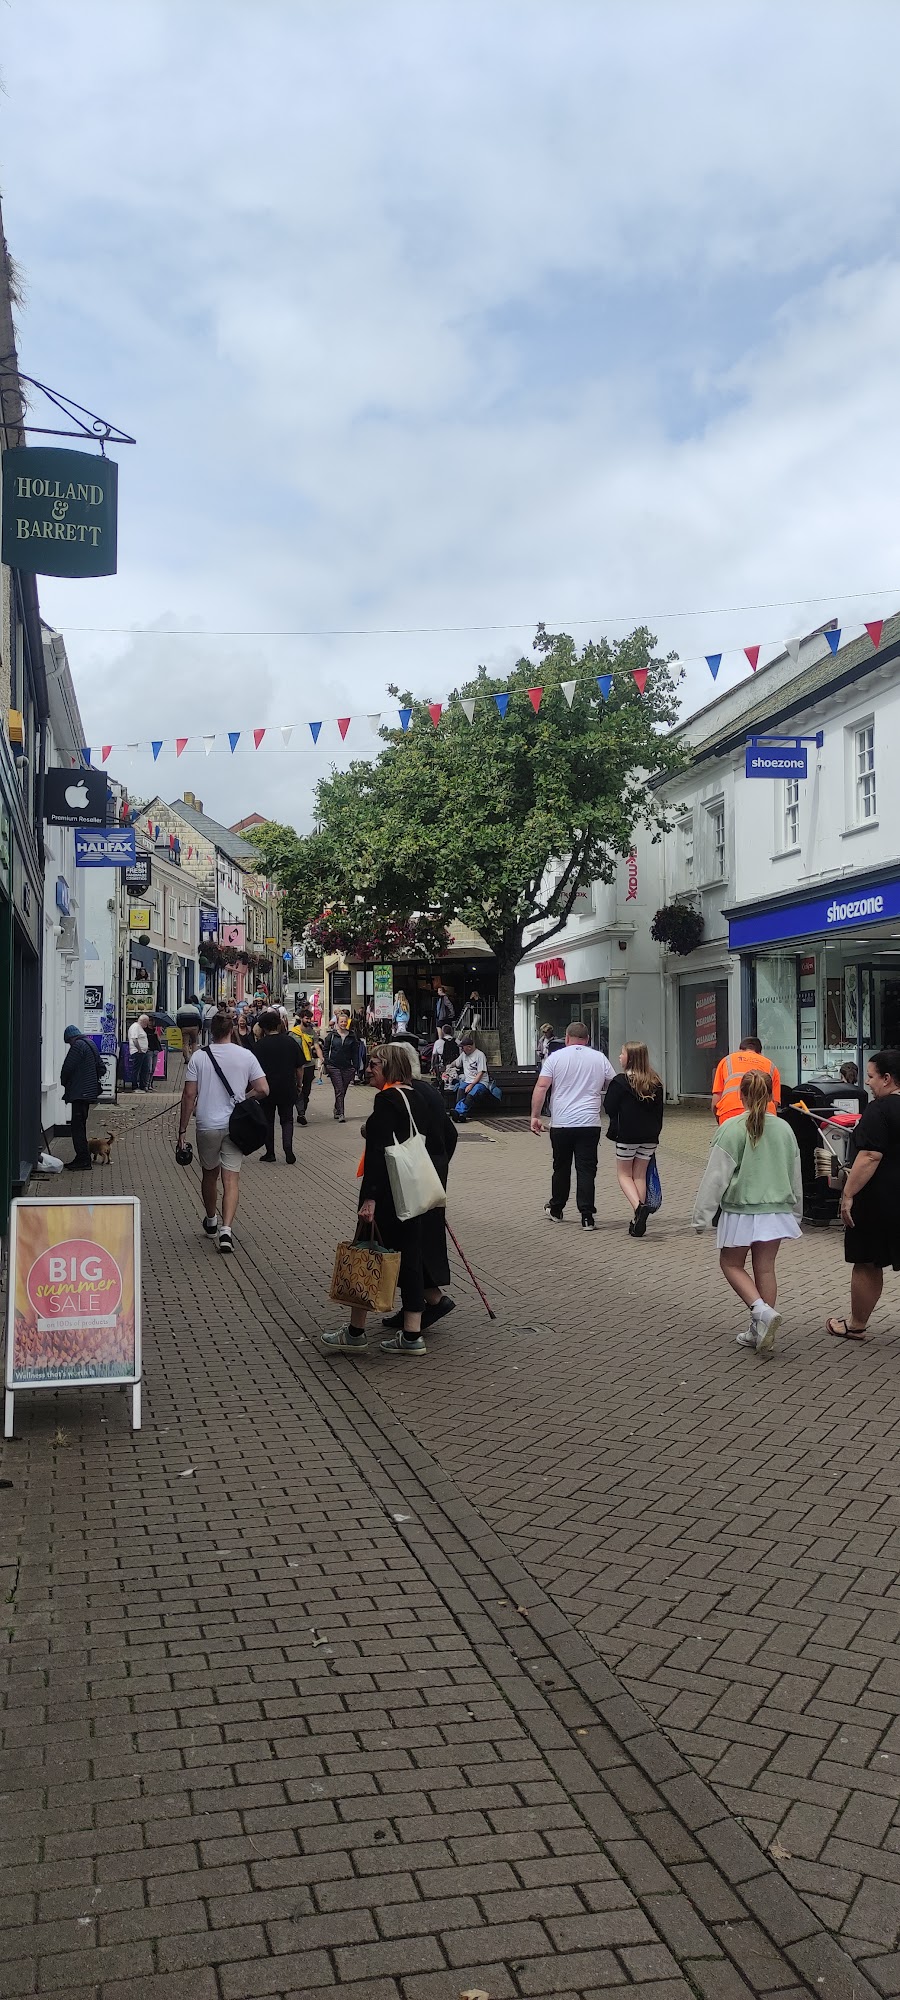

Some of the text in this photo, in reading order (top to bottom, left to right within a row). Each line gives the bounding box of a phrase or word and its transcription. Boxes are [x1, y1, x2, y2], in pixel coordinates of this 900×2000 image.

[16, 477, 104, 505] HOLLAND
[51, 500, 69, 521] &
[16, 518, 102, 546] BARRETT
[751, 757, 805, 768] shoezone
[51, 813, 103, 824] Premium Reseller
[76, 842, 133, 853] HALIFAX
[826, 895, 884, 923] shoezone
[695, 993, 716, 1009] CLEARANCE
[695, 1012, 716, 1028] CLEARANCE
[695, 1031, 717, 1046] CLEARANCE
[49, 1256, 103, 1283] BIG
[36, 1278, 117, 1298] summer
[49, 1294, 101, 1313] SALE
[56, 1320, 73, 1328] 100s
[81, 1318, 109, 1328] products
[15, 1371, 46, 1380] Wellness
[46, 1370, 66, 1379] that's
[68, 1369, 89, 1378] worth
